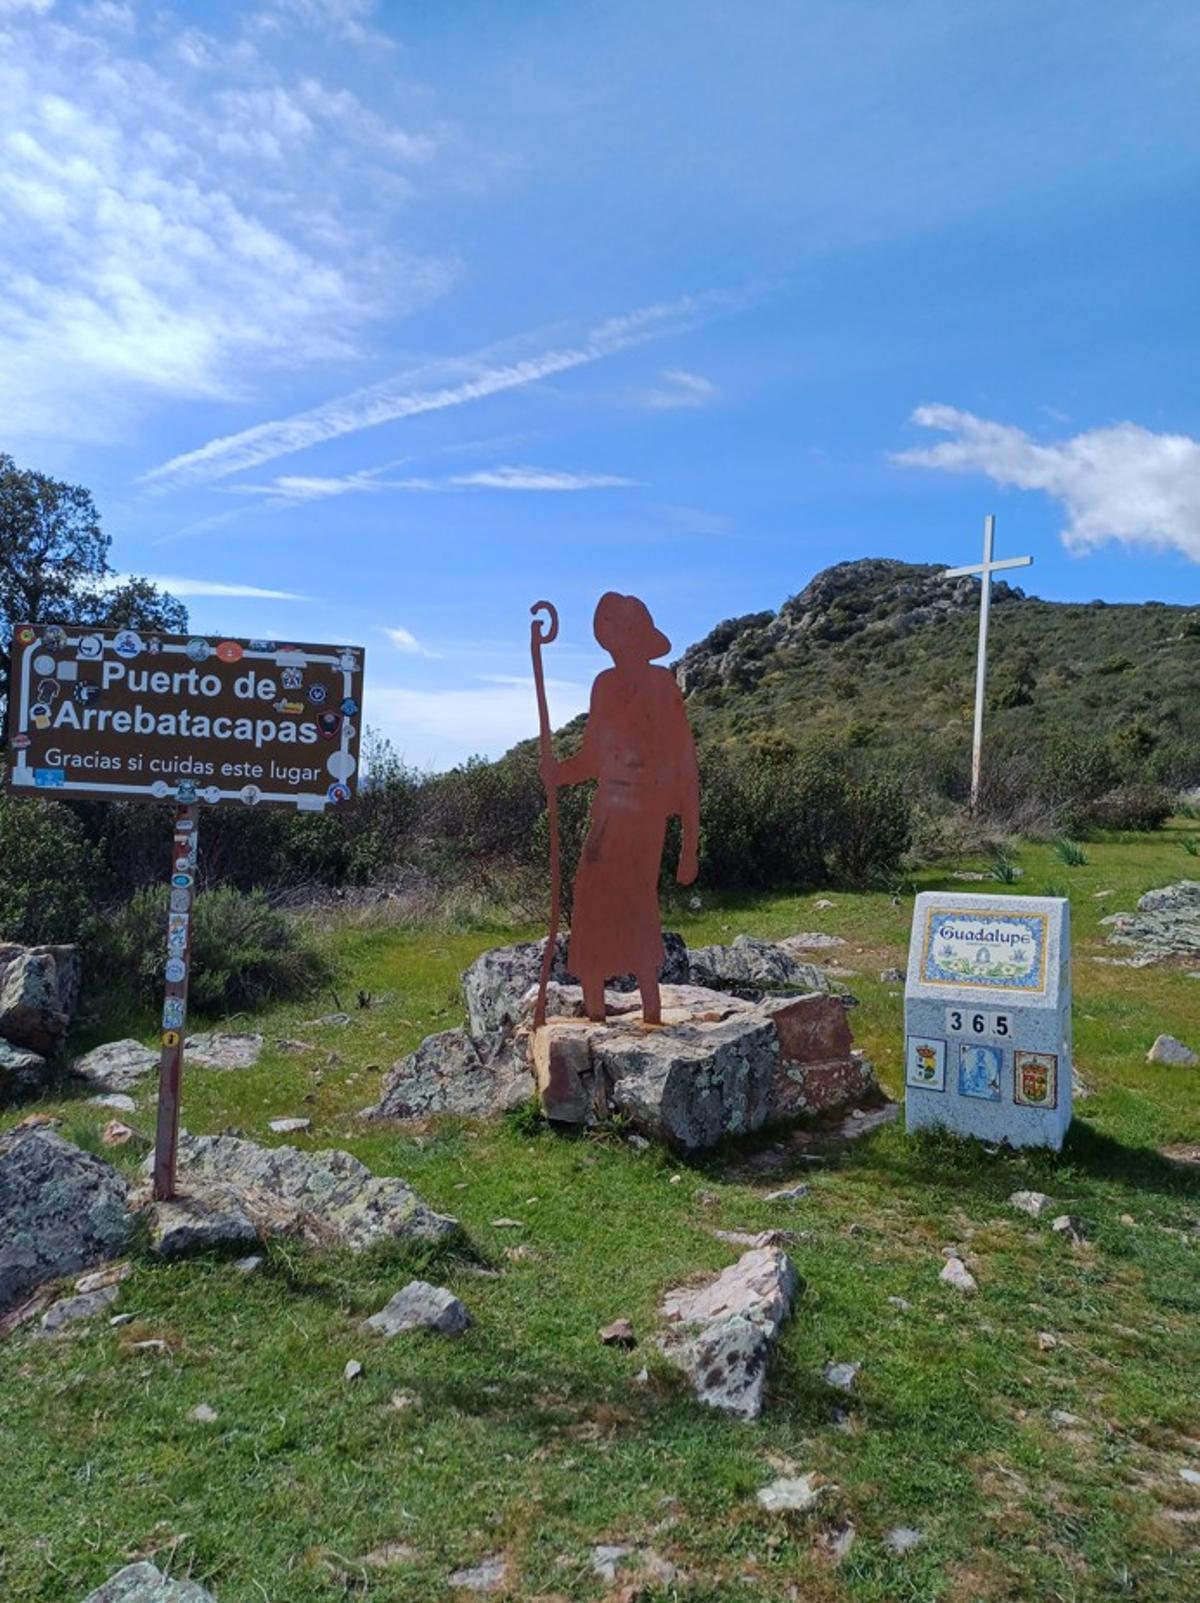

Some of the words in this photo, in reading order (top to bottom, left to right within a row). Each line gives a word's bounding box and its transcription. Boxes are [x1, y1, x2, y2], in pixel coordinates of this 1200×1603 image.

[102, 661, 222, 697] Puerto
[234, 671, 277, 700] de
[53, 700, 318, 748] Arrebatacapas
[45, 748, 121, 769] Gracias
[128, 754, 143, 771] si
[150, 754, 214, 775] cuidas
[221, 762, 263, 777] este
[270, 760, 321, 785] lugar
[939, 926, 1031, 947] Guadalupe
[951, 1011, 1009, 1036] 365
